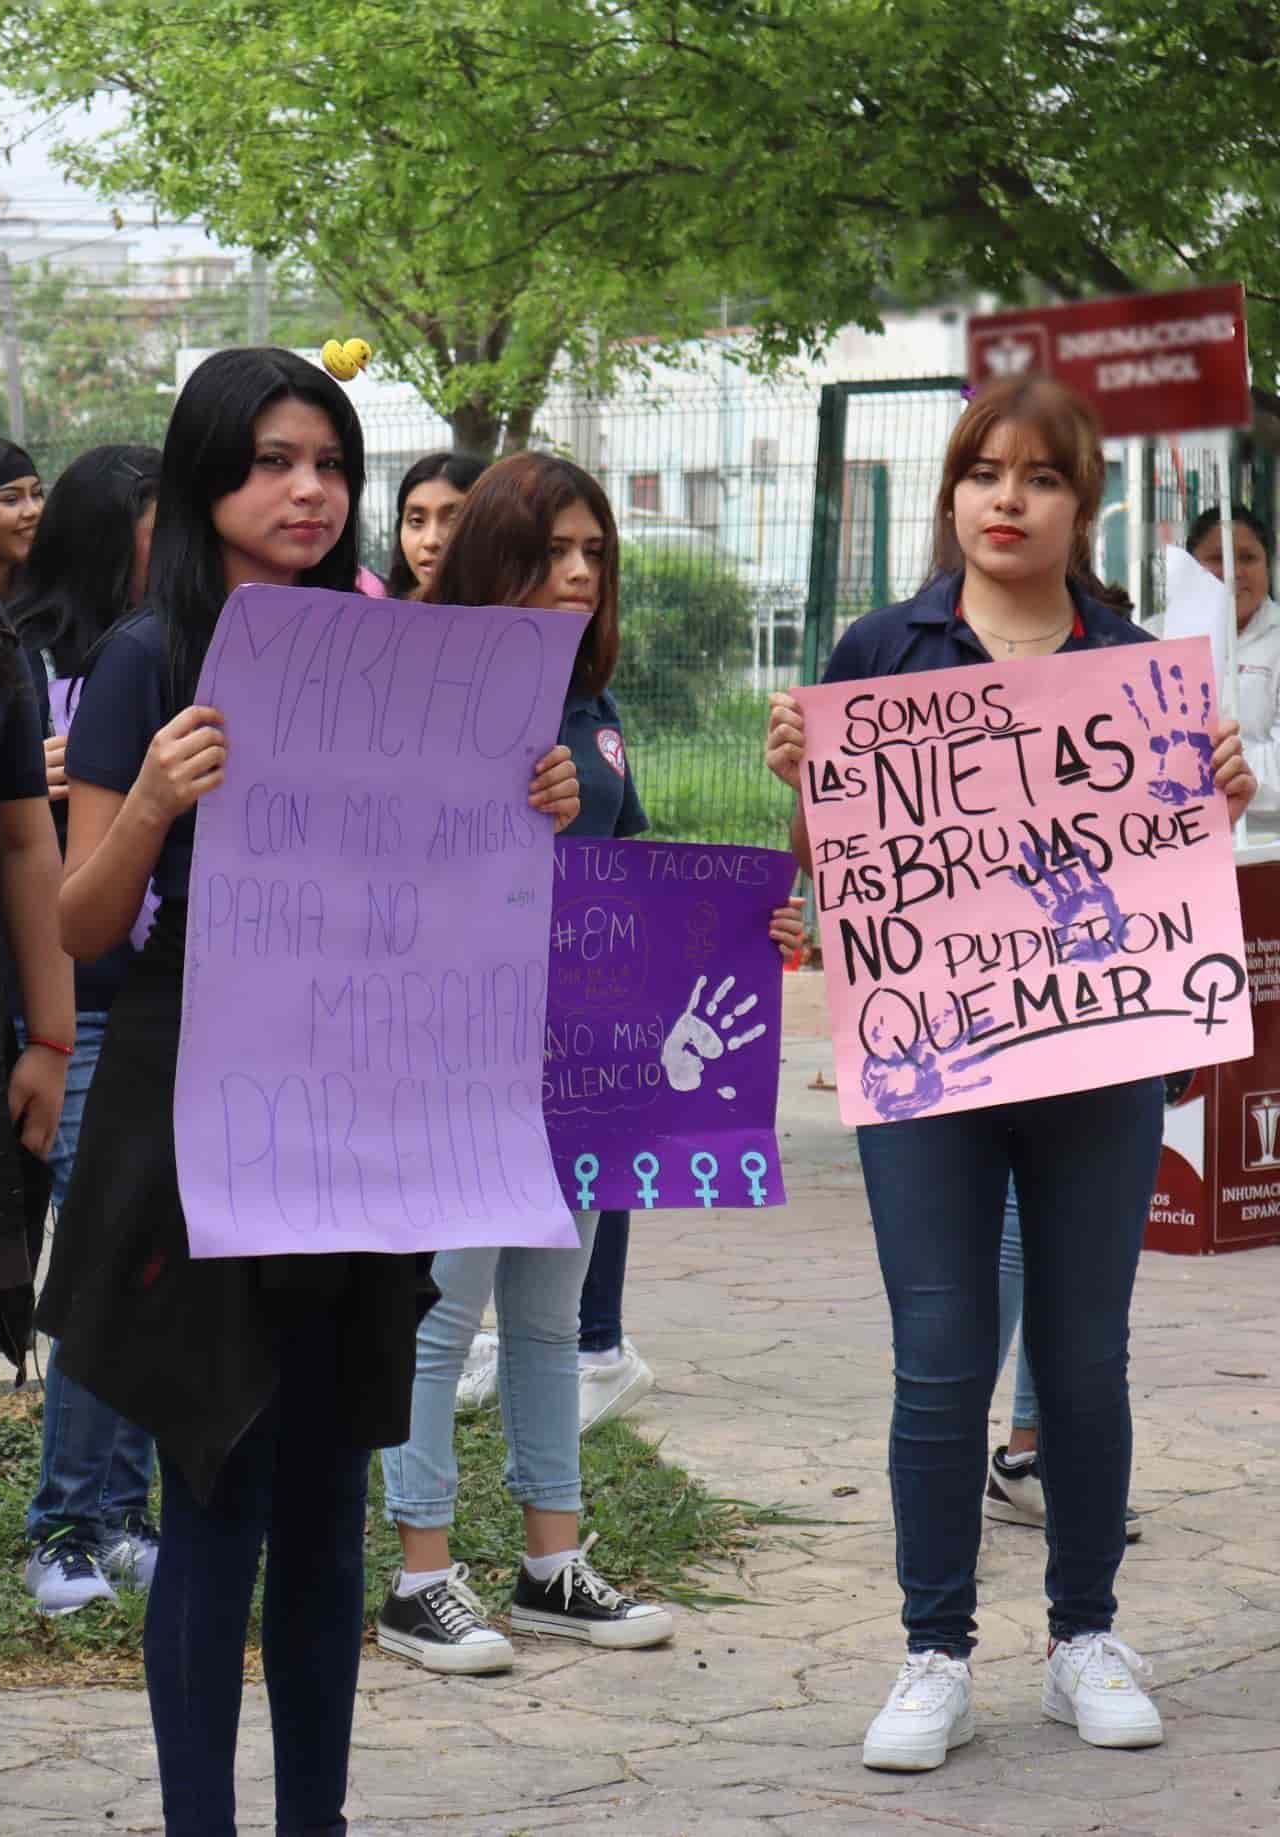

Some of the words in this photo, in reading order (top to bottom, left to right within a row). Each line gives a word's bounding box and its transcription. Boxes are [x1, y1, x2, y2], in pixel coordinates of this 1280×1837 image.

[844, 684, 1013, 750] SOMOS
[807, 758, 867, 804] LAS
[874, 713, 1136, 830] NIETAS
[245, 781, 310, 857] CON
[339, 792, 402, 857] MIS
[426, 800, 536, 863] AMIGAS
[815, 833, 869, 867] DE
[819, 864, 888, 912] LAS
[879, 811, 1114, 914] BRUJAS
[1120, 806, 1210, 861] QUE
[576, 845, 627, 882] TUS
[647, 849, 770, 887] TACONES
[207, 872, 324, 960] PARA
[365, 879, 421, 958] NO
[552, 906, 636, 961] #8M
[839, 912, 922, 986] NO
[934, 902, 1195, 978] PUDIERON
[547, 1023, 595, 1057] NO
[859, 964, 1153, 1069] QUEMAR
